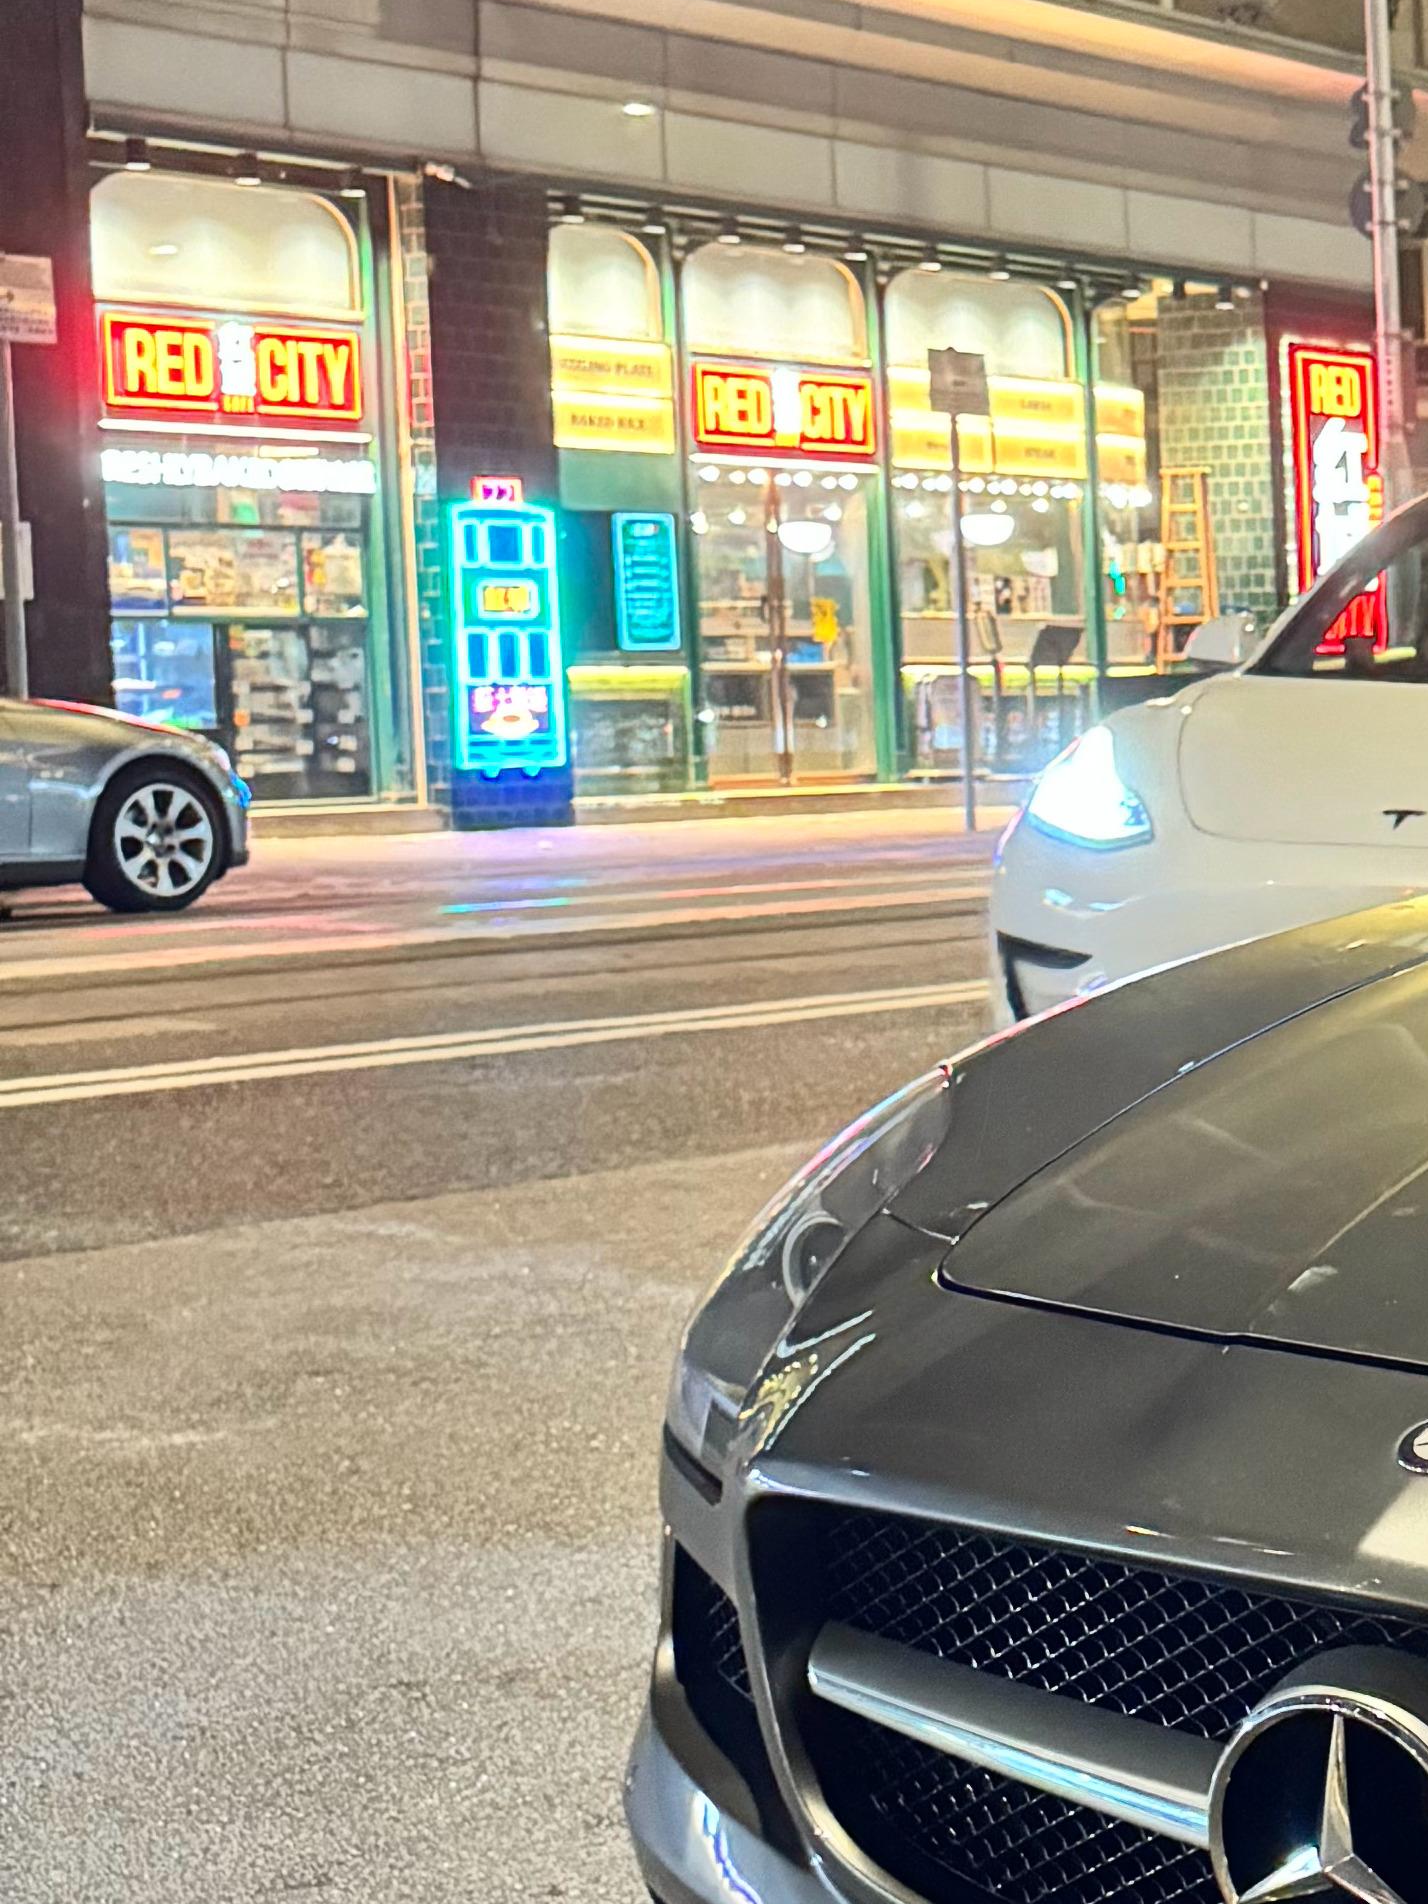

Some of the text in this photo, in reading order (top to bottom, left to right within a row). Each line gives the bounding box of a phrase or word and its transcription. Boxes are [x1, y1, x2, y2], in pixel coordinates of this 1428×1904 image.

[124, 327, 215, 397] RED
[258, 337, 350, 406] CITY
[1309, 363, 1361, 417] RED
[703, 375, 773, 435] RED
[800, 382, 867, 442] CITY
